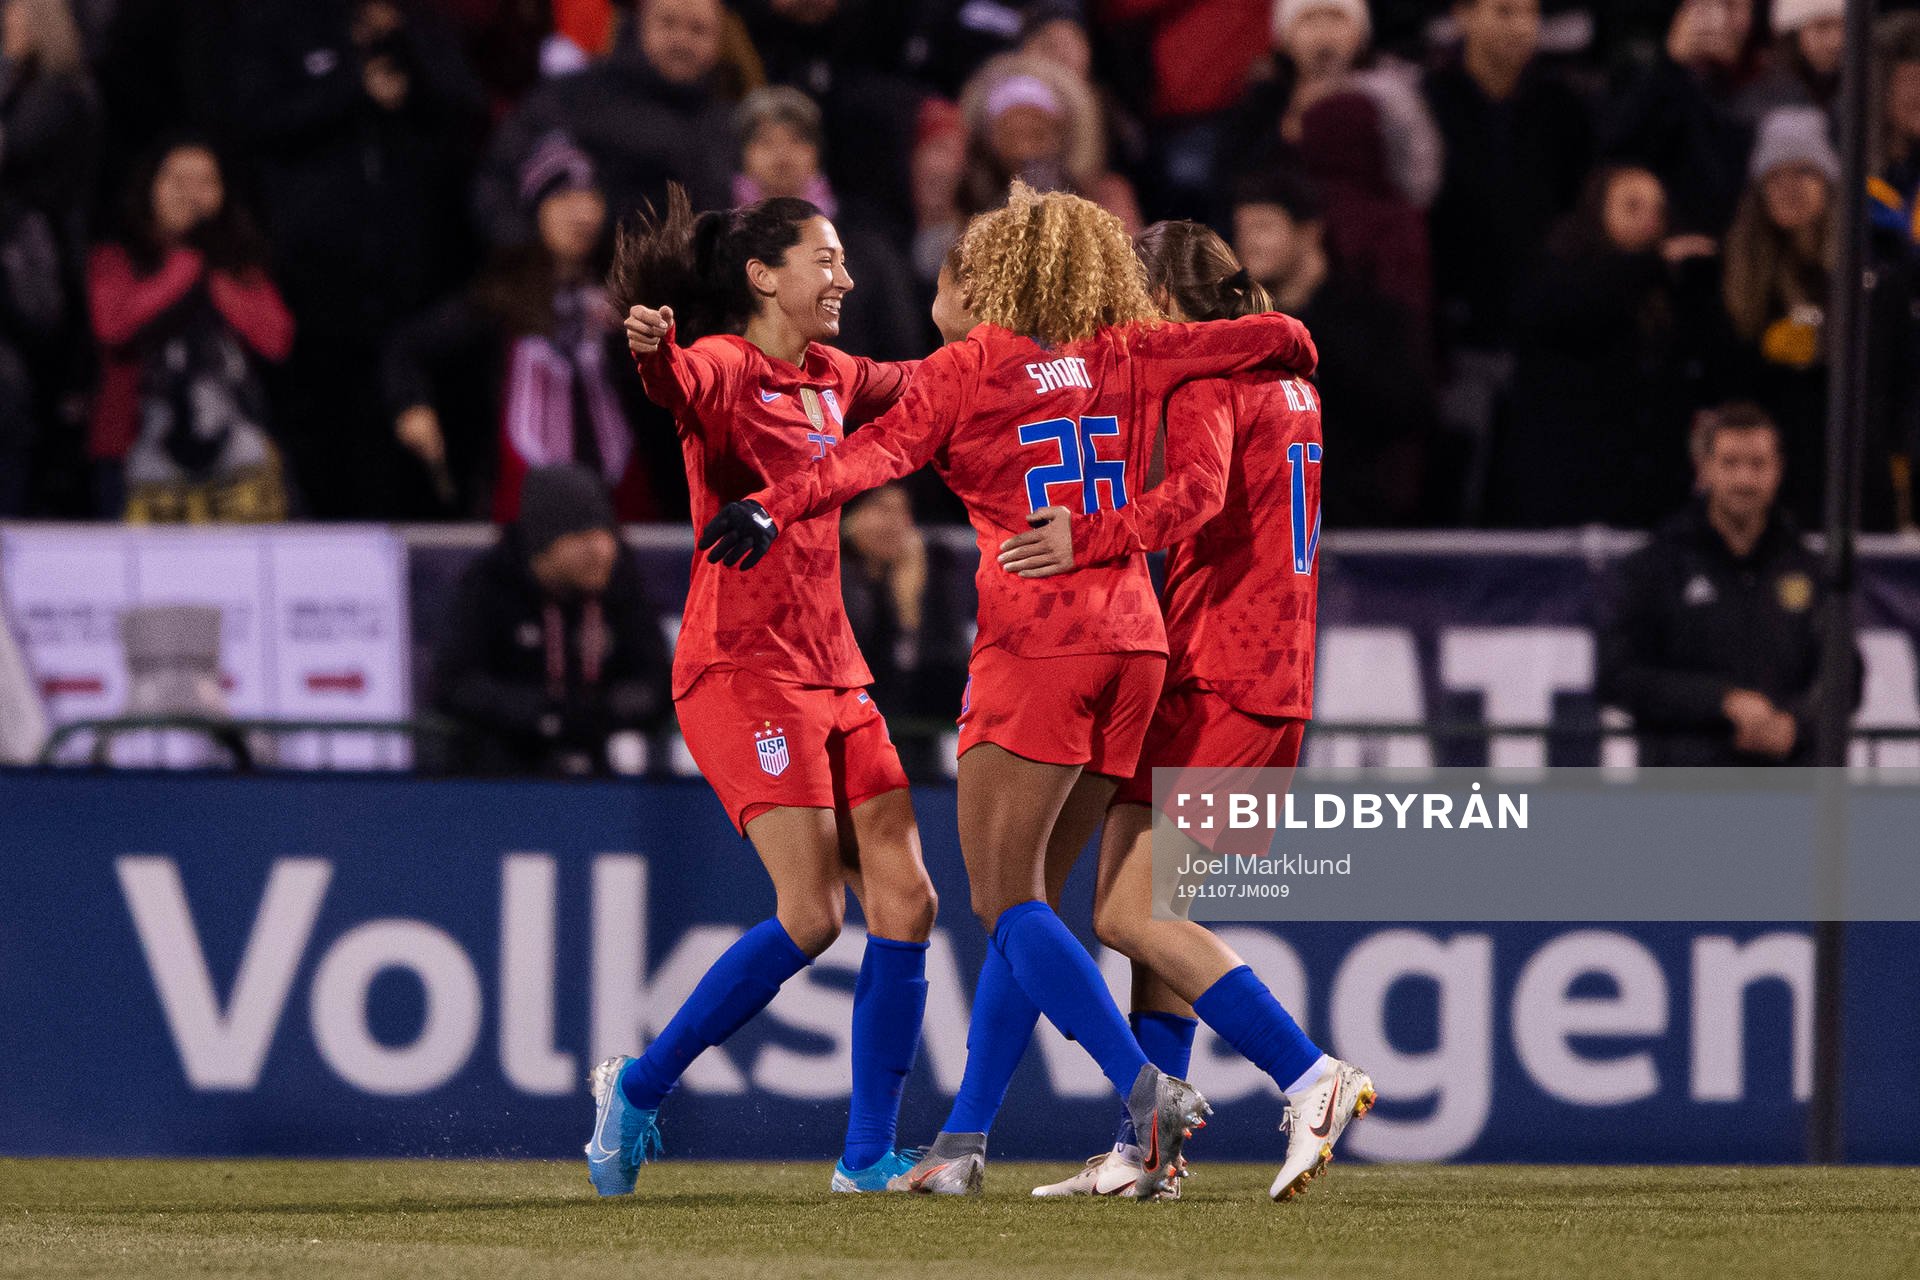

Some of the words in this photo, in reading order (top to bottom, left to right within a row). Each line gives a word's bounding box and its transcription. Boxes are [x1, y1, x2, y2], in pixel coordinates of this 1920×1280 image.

[1025, 356, 1093, 395] SHORT
[807, 432, 837, 462] 2
[1017, 415, 1130, 515] 26
[758, 738, 785, 754] USA
